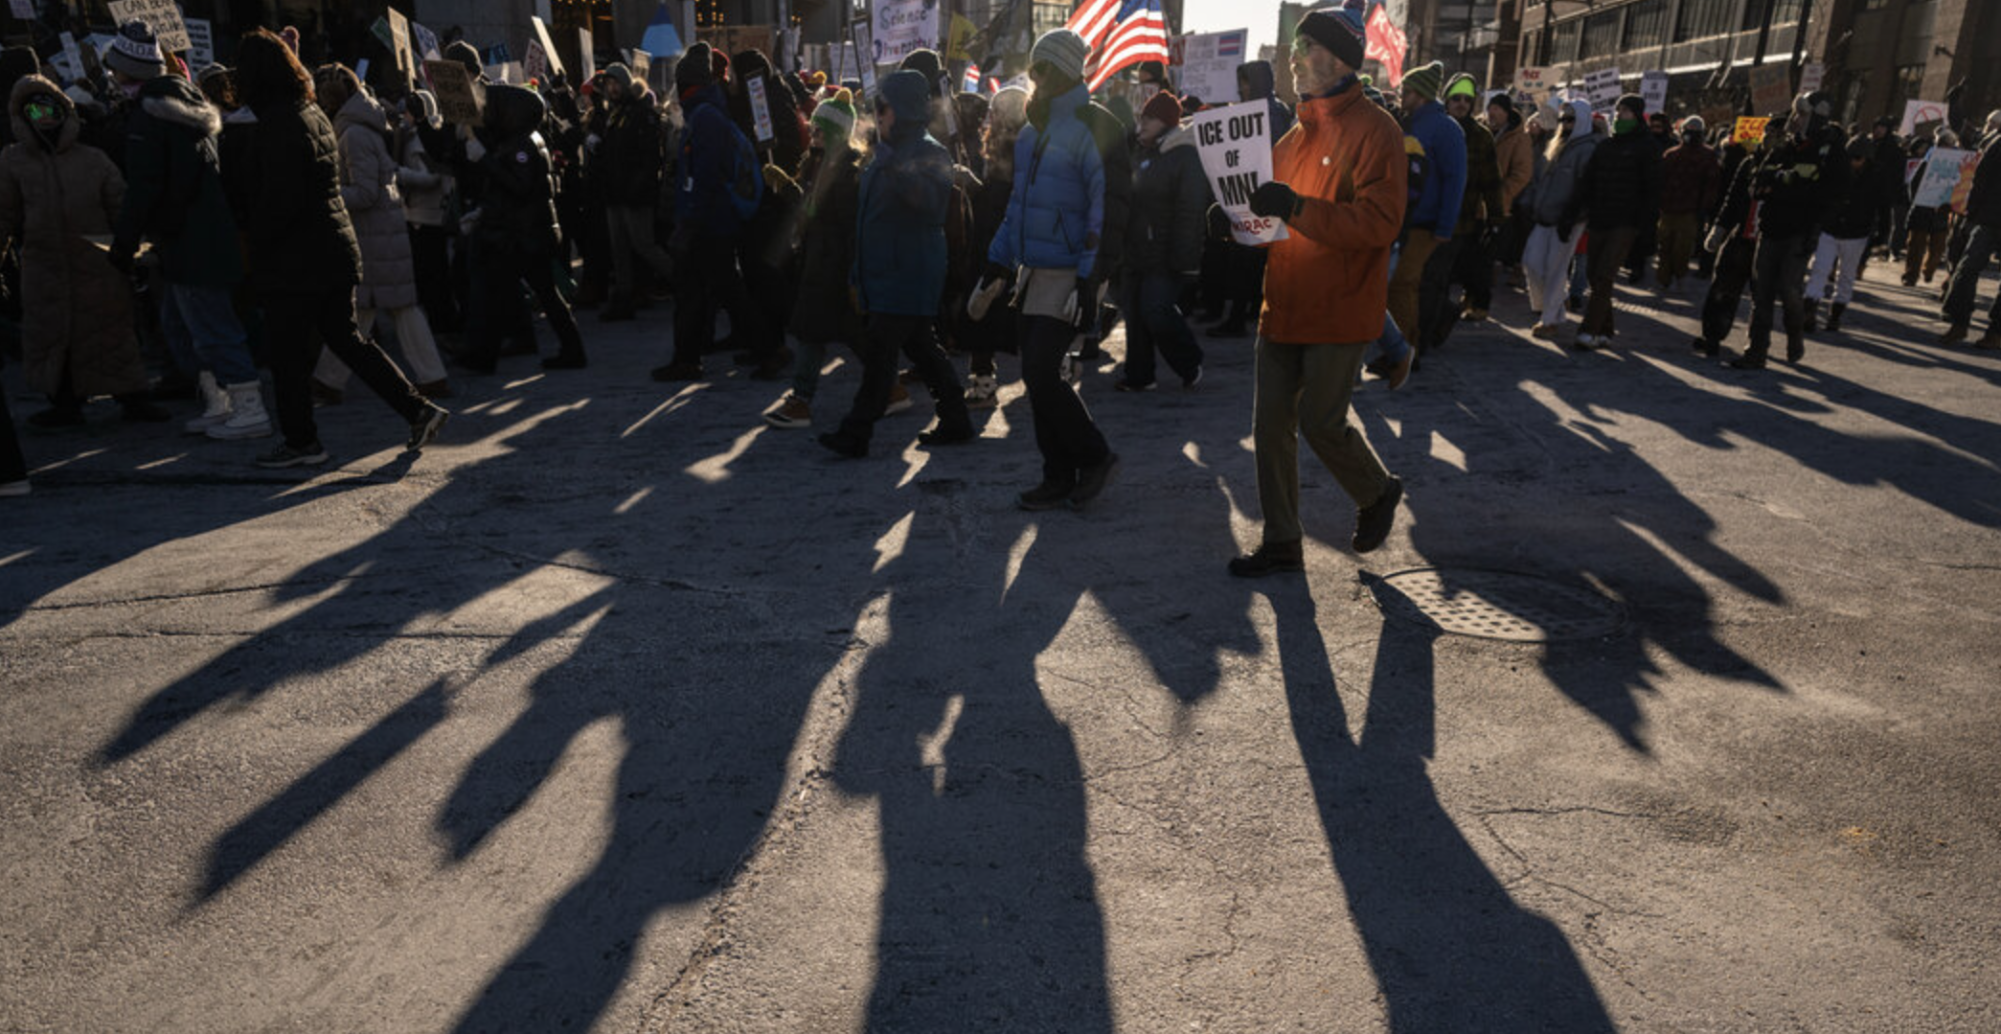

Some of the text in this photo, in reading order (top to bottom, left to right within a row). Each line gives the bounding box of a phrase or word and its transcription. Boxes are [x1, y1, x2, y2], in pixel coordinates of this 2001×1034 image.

[880, 6, 928, 30] Science
[1198, 112, 1264, 147] ICE OUT
[1225, 150, 1240, 168] OF
